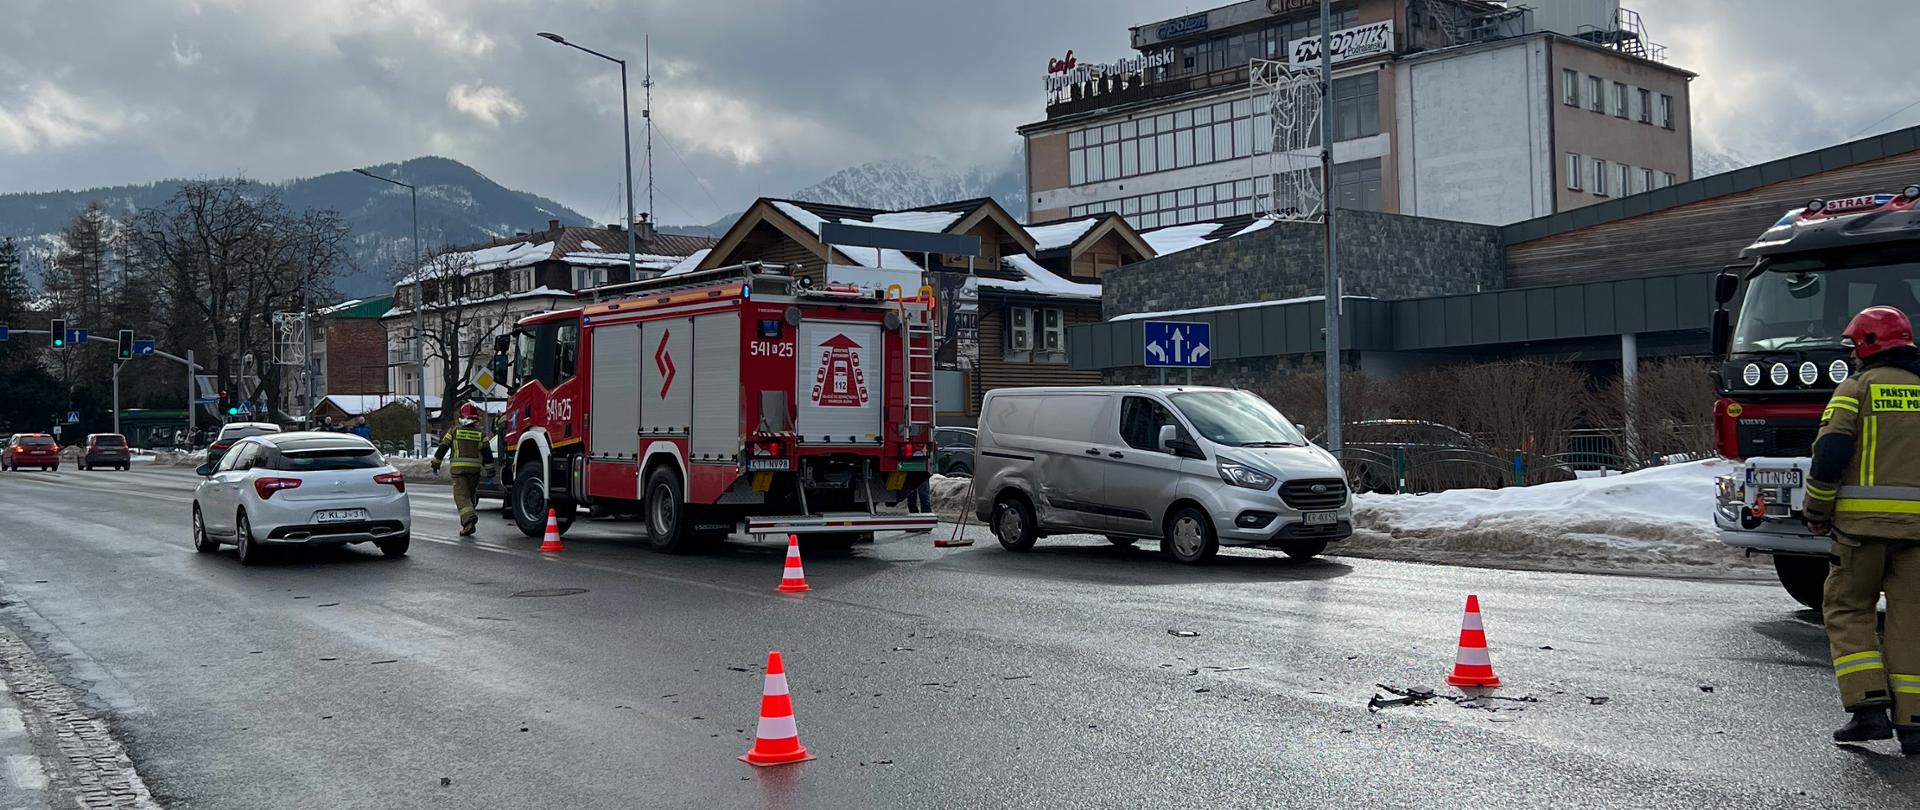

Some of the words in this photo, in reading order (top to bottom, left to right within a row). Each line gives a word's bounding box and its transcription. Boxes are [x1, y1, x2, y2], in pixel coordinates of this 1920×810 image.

[1295, 24, 1388, 62] TYODNIK
[835, 381, 847, 390] 112
[1880, 387, 1920, 398] PAŃSTW
[1907, 400, 1920, 409] PO
[1753, 471, 1771, 484] KTT
